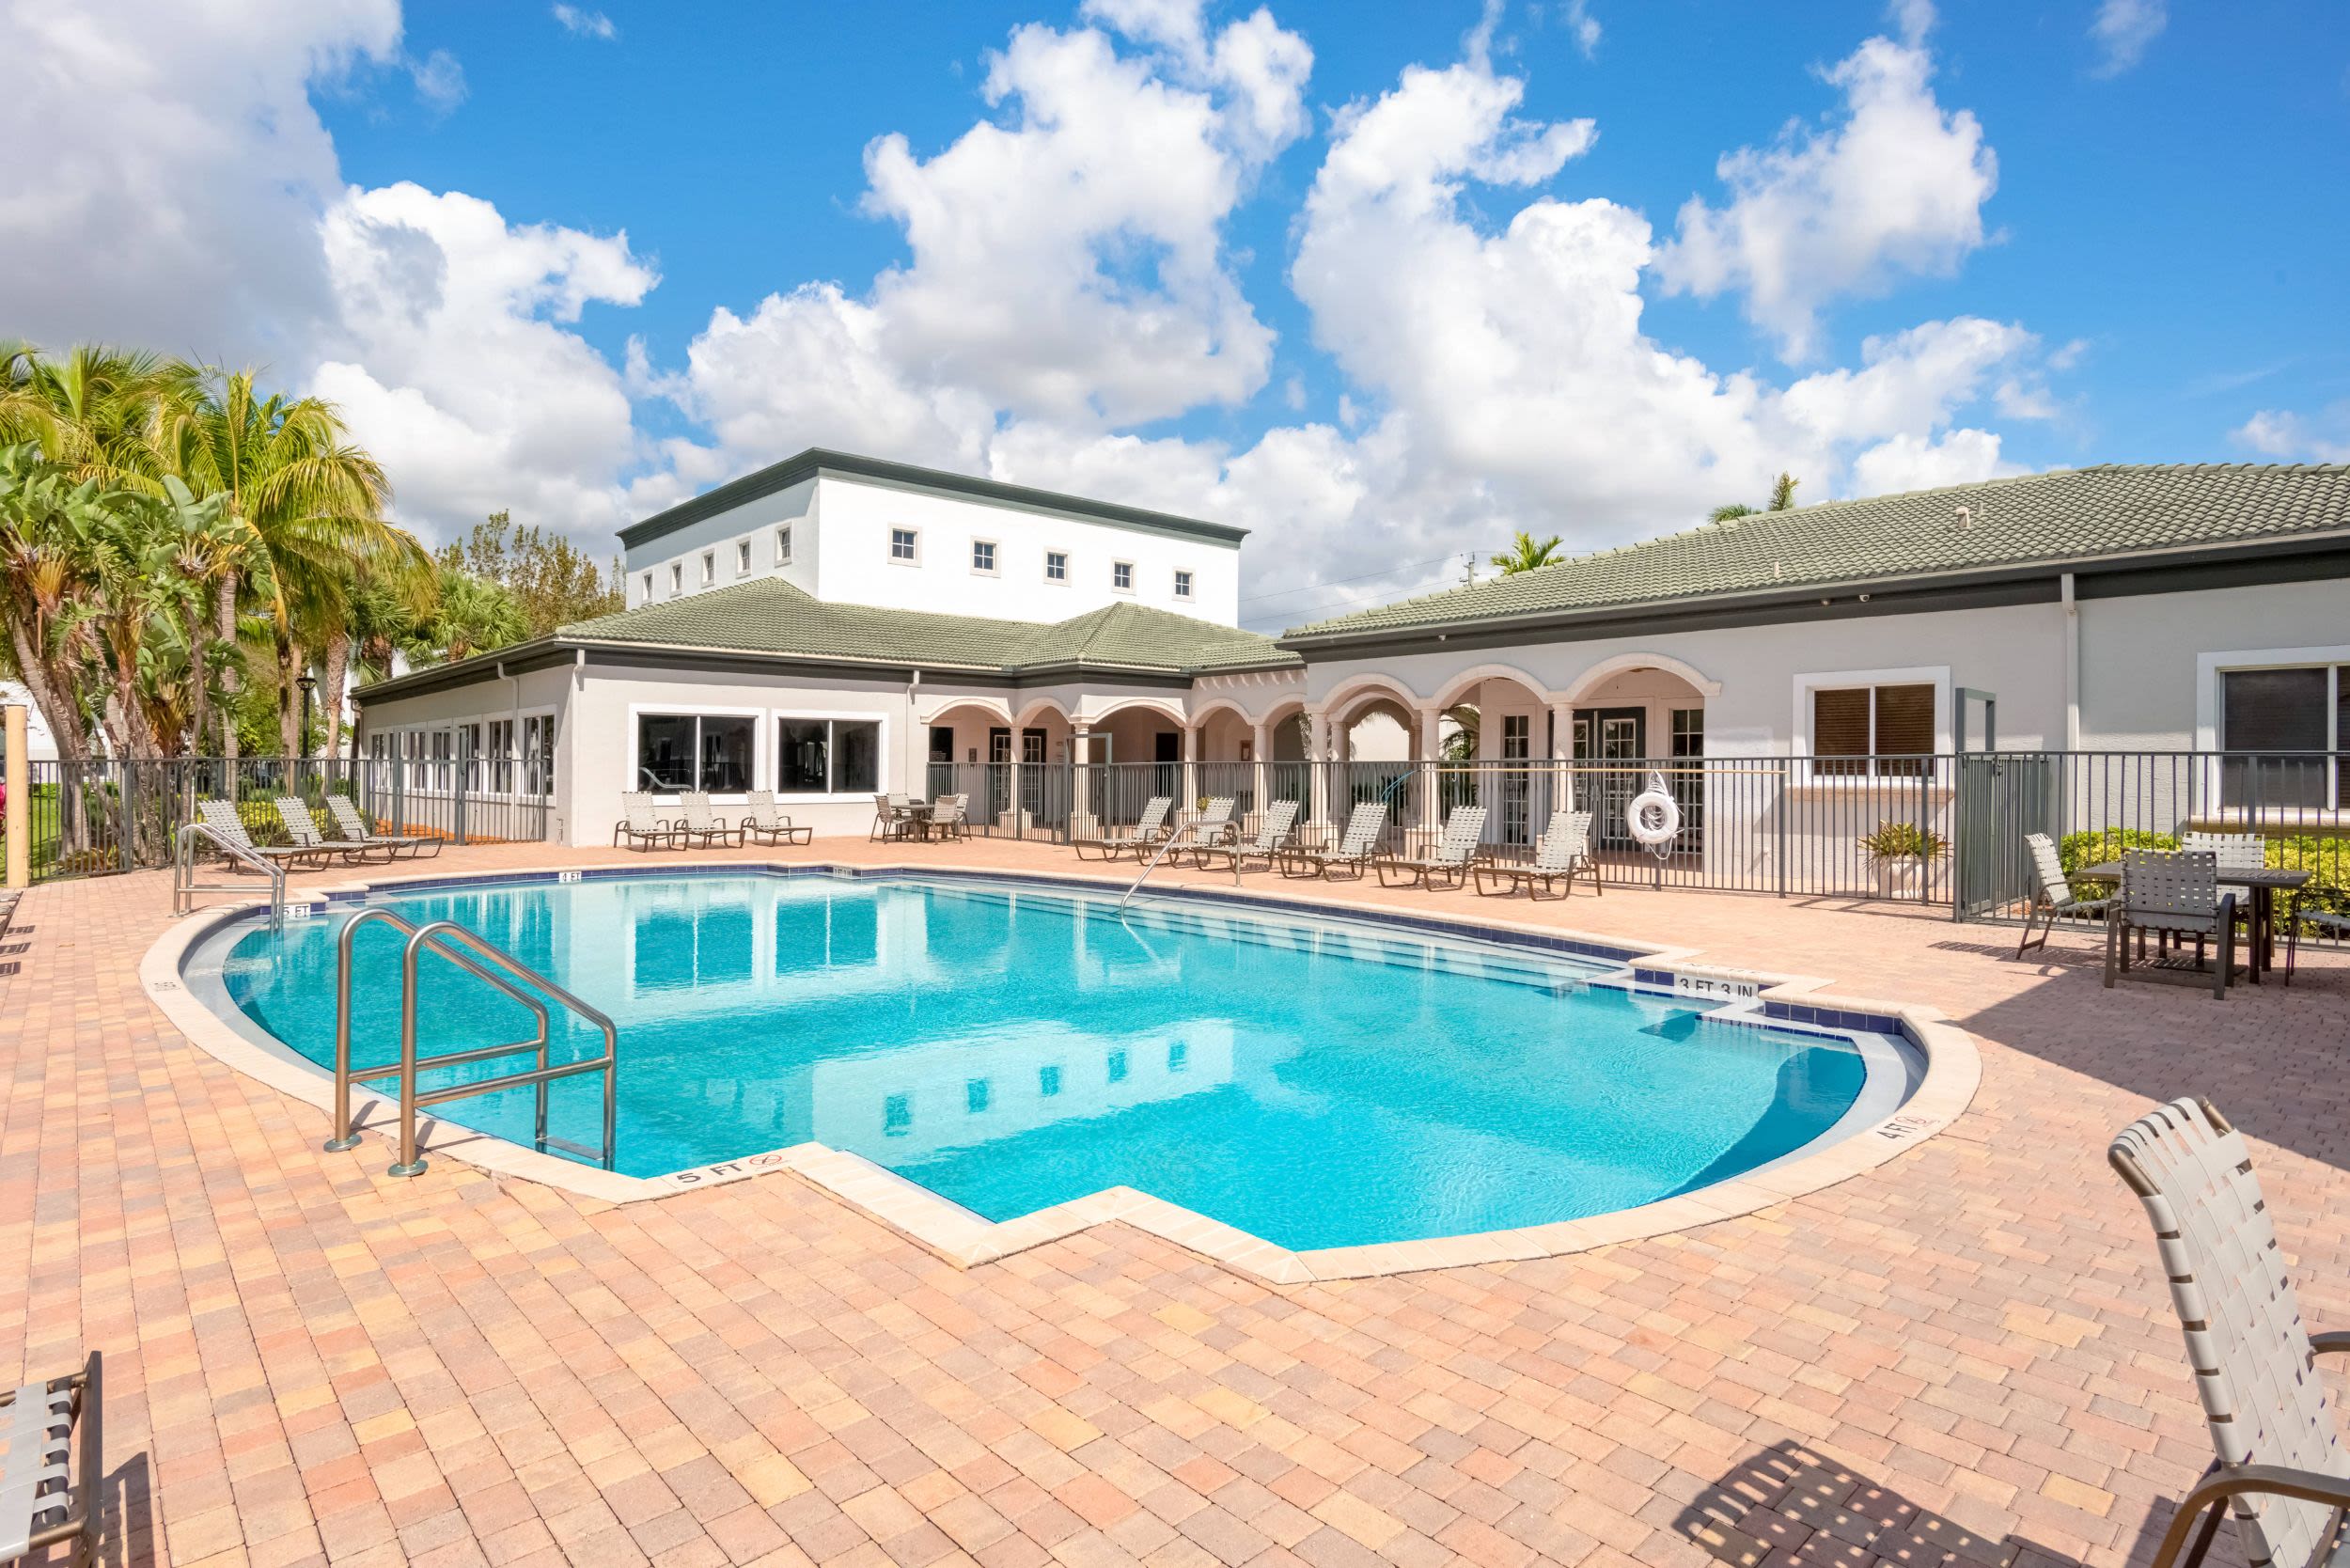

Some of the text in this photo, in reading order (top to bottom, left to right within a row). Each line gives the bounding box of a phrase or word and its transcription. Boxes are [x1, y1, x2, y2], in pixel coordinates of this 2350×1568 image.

[571, 871, 581, 881] FT
[295, 905, 309, 917] FT
[1680, 978, 1752, 997] 3 FT 3 IN
[1884, 1122, 1918, 1133] FT
[1876, 1131, 1904, 1139] 4
[676, 1172, 701, 1184] 5
[710, 1163, 742, 1176] FT
